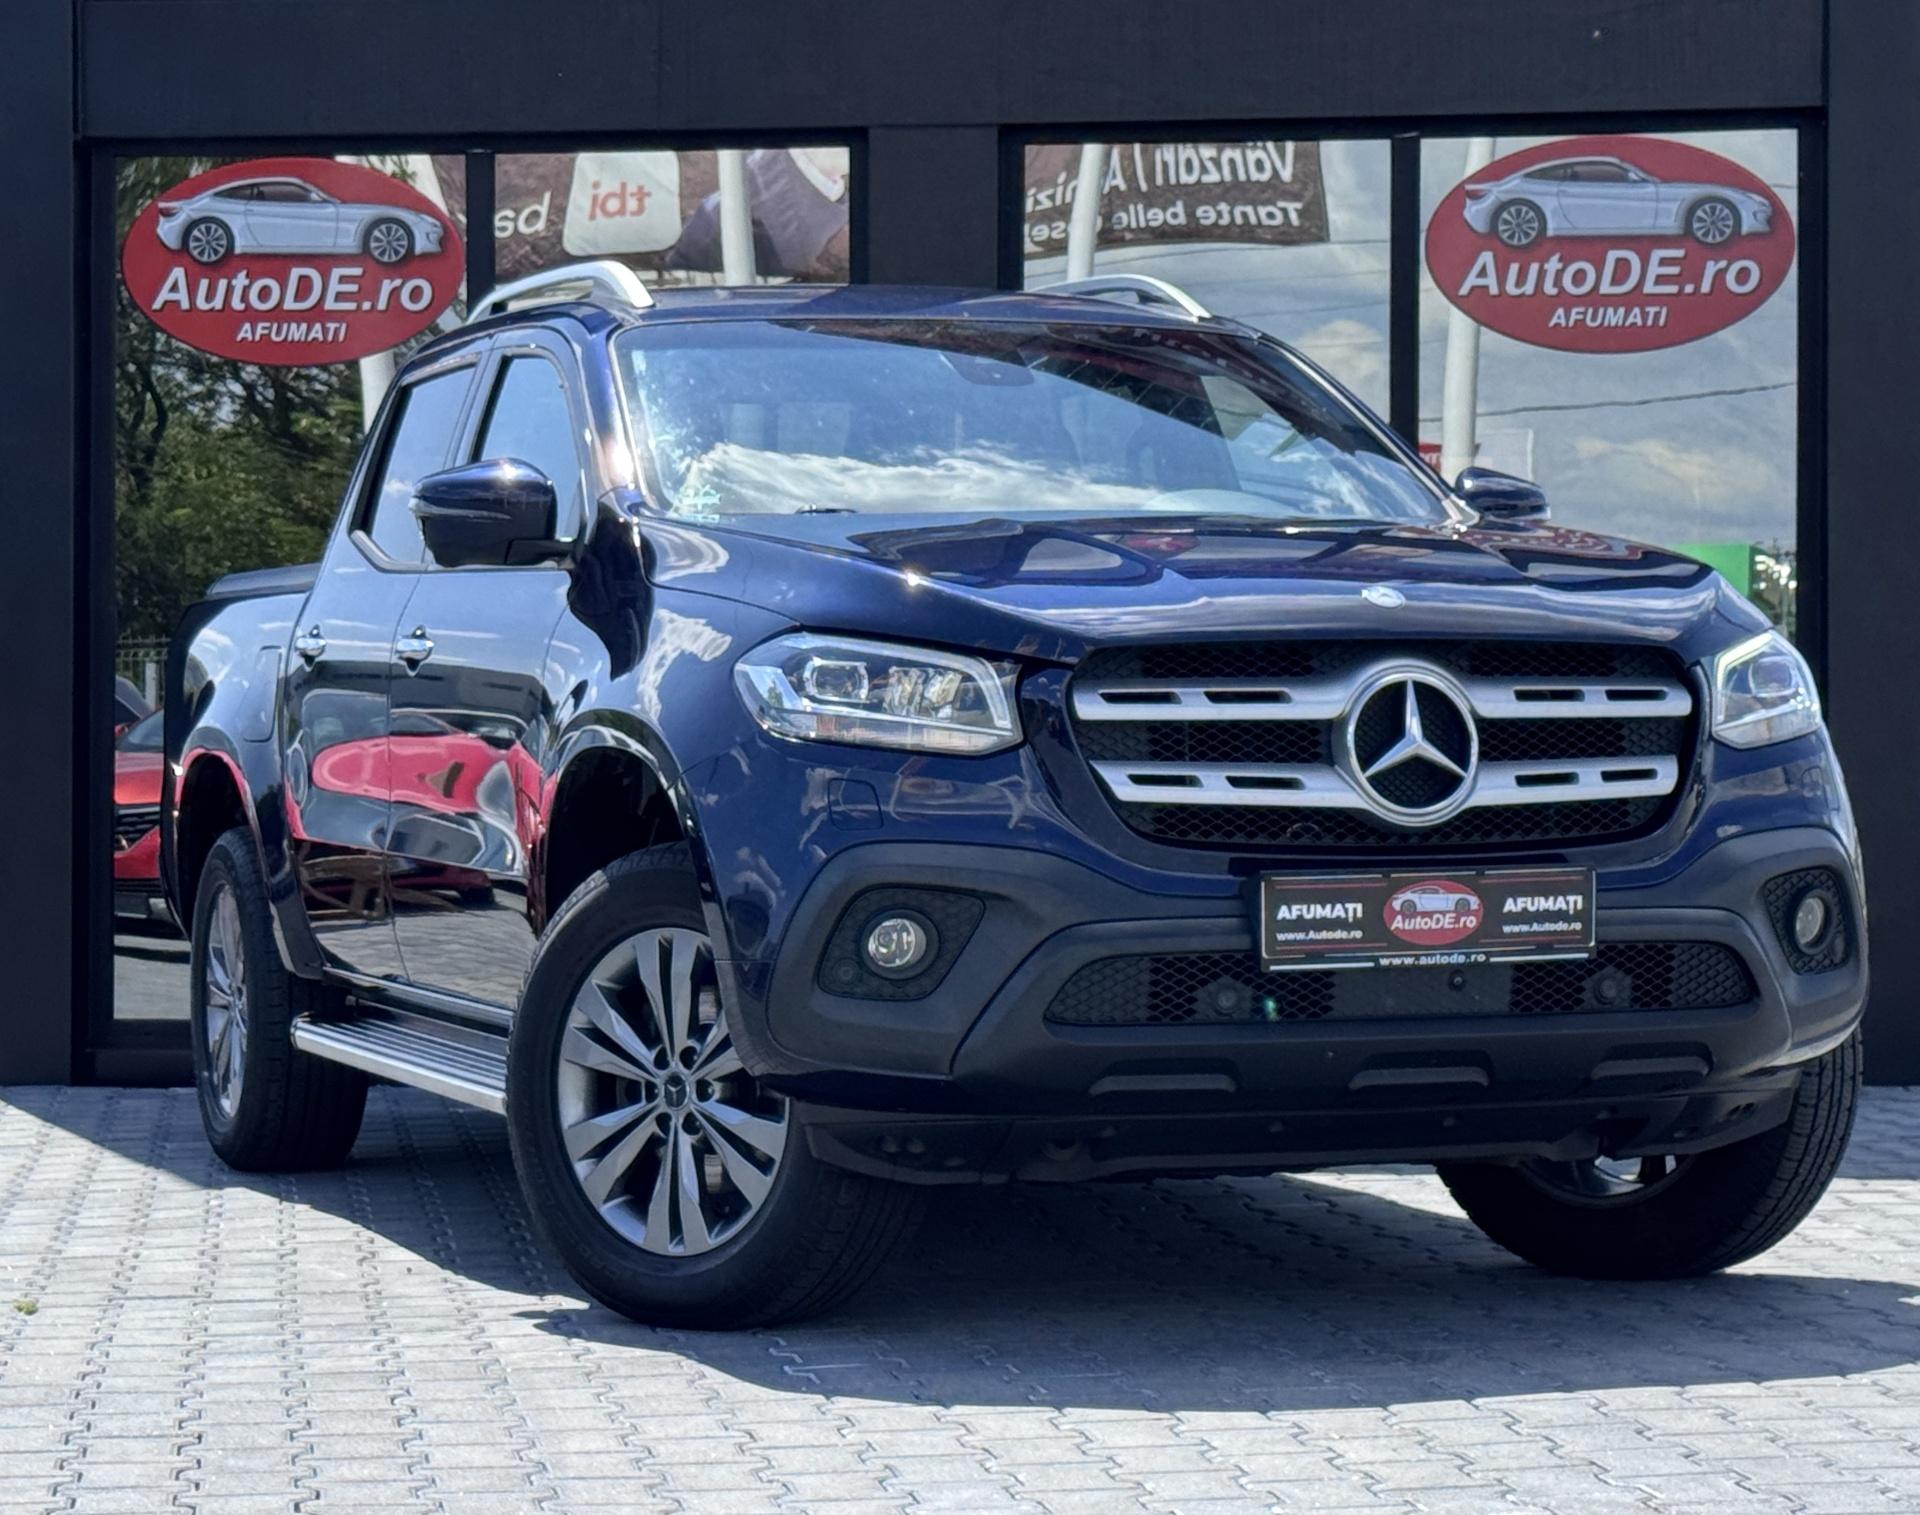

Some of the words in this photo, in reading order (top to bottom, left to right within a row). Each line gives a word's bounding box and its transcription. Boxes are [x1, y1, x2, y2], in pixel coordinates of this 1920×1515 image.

[1458, 248, 1761, 296] AutoDE.ro
[152, 267, 434, 312] AutoDE.ro
[1549, 306, 1667, 327] AFUMATI
[236, 322, 348, 342] AFUMATI
[1390, 913, 1478, 931] AutoDE.ro
[1502, 920, 1583, 934] www.Autode.ro
[1276, 929, 1364, 941] www.Autode.ro
[1379, 953, 1487, 967] www.autode.ro
